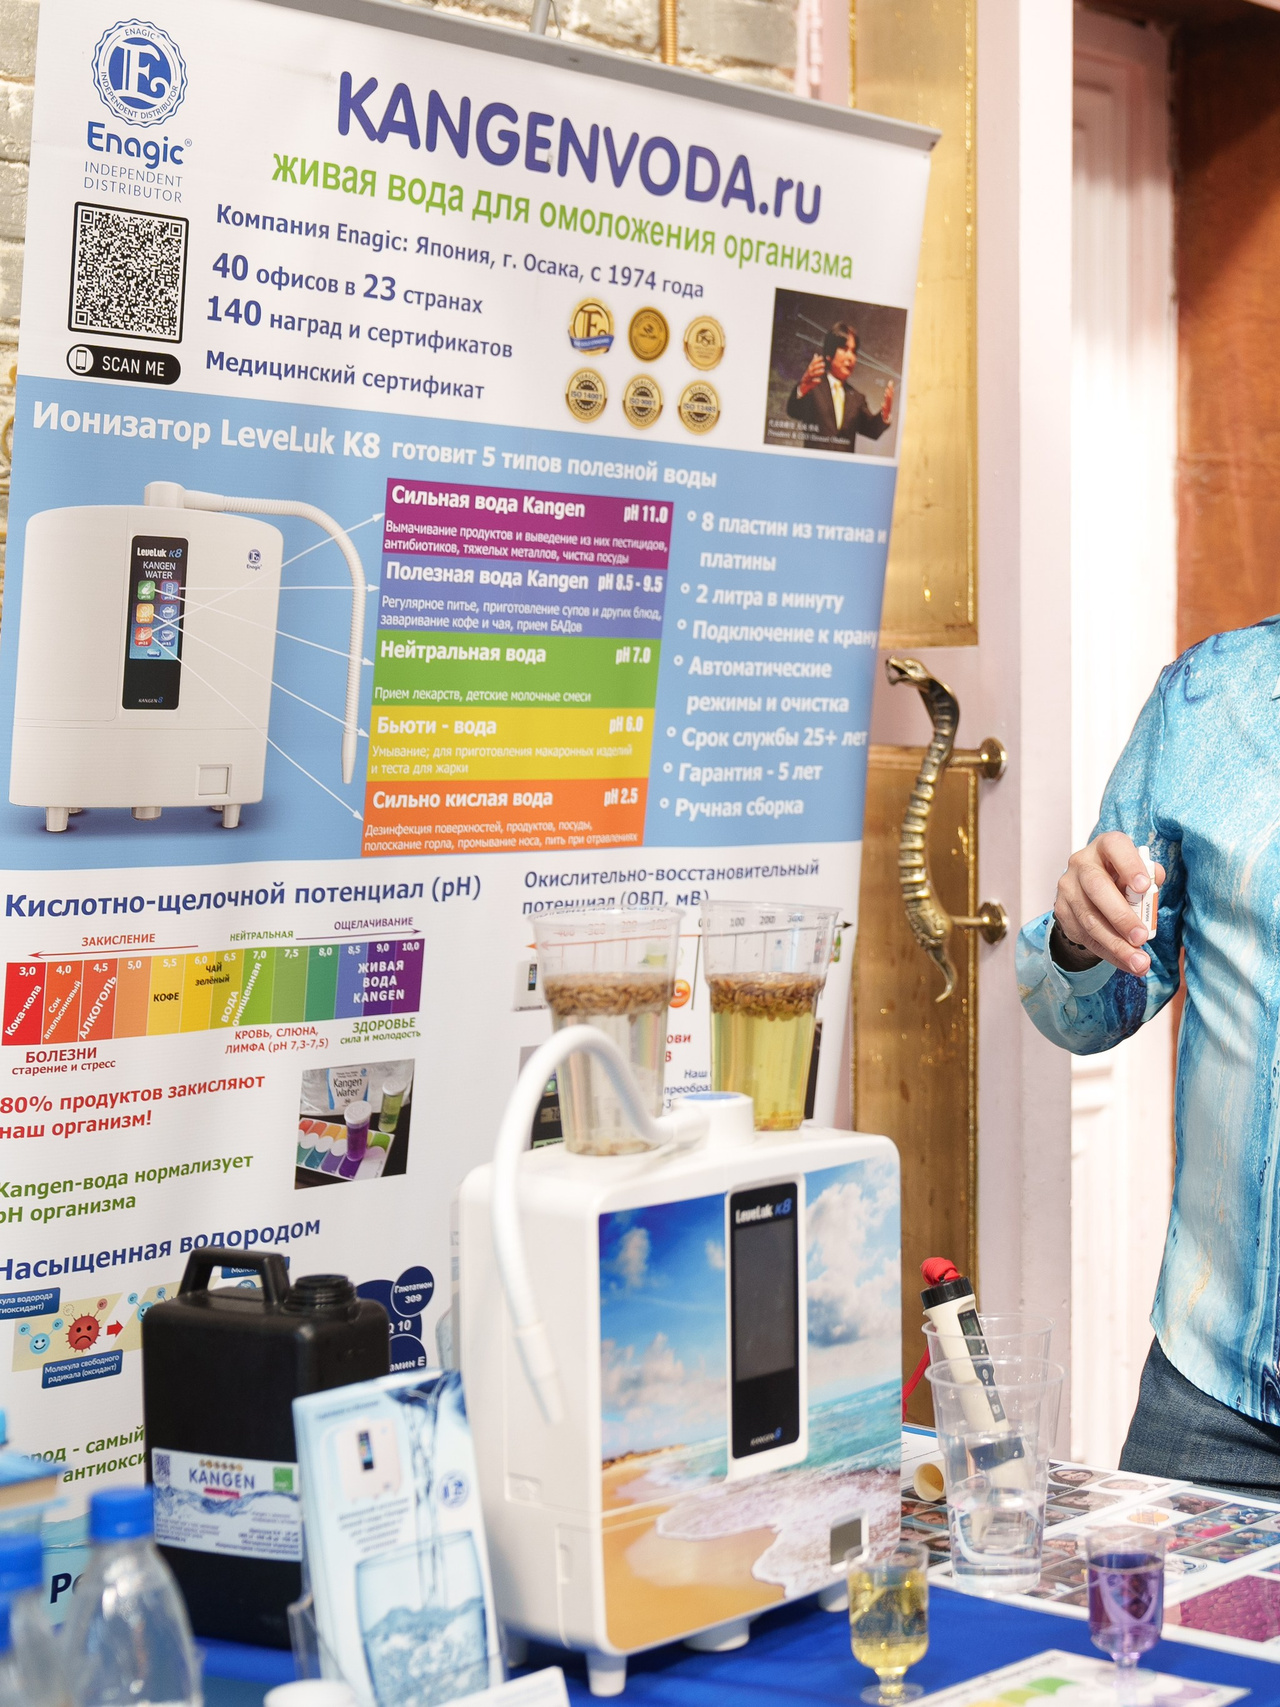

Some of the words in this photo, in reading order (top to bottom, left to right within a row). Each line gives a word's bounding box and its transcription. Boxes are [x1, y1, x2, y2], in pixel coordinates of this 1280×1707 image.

[101, 71, 138, 118] INDEPENDENT
[140, 85, 179, 119] DISTRIBUTOR
[338, 71, 821, 224] KANGENVODA.ru
[85, 161, 183, 188] INDEPENDENT
[84, 177, 182, 203] DISTRIBUTOR
[272, 153, 376, 197] живая
[388, 174, 464, 216] вода
[472, 190, 530, 224] для
[540, 202, 716, 255] омоложения
[724, 233, 853, 280] организма
[217, 204, 330, 240] Компания
[337, 222, 408, 254] Enagic:
[416, 236, 496, 269] Япония,
[524, 253, 584, 284] Осака,
[609, 265, 656, 290] 1974
[663, 277, 704, 299] года
[212, 252, 249, 281] 40
[256, 265, 339, 296] офисов
[363, 273, 396, 301] 23
[402, 286, 483, 315] странах
[207, 295, 262, 327] 140
[269, 309, 342, 340] наград
[367, 325, 513, 360] сертификатов
[102, 355, 139, 374] SCAN
[145, 359, 165, 376] ME
[206, 350, 355, 387] Медицинский
[362, 370, 485, 400] сертификат
[33, 401, 211, 449] Ионизатор
[221, 419, 334, 455] LeveLuk
[343, 431, 381, 458] K8
[392, 443, 476, 466] готовит
[502, 451, 561, 473] типов
[567, 462, 657, 482] полезной
[664, 467, 717, 489] воды
[392, 485, 470, 508] Сильная
[475, 496, 517, 514] вода
[523, 496, 585, 520] Kangen
[643, 505, 668, 523] 11.0
[386, 520, 457, 538] Вымачивание
[460, 527, 512, 543] продуктов
[525, 533, 578, 545] выведение
[719, 517, 787, 537] пластин
[816, 525, 874, 543] титана
[385, 538, 459, 557] антибиотиков,
[143, 561, 176, 571] KANGEN
[700, 553, 776, 571] платины
[145, 571, 172, 579] WATER
[386, 562, 474, 584] Полезная
[480, 568, 522, 588] вода
[527, 570, 588, 592] Kangen
[382, 596, 444, 612] Регулярное
[483, 602, 560, 617] приготовление
[712, 588, 764, 609] литра
[782, 593, 844, 613] минуту
[381, 615, 449, 628] заваривание
[452, 616, 479, 630] кофе
[692, 620, 814, 643] Подключение
[381, 640, 500, 661] Нейтральная
[506, 647, 546, 664] вода
[688, 656, 832, 678] Автоматические
[375, 687, 409, 700] Прием
[413, 689, 463, 702] лекарств,
[466, 689, 507, 702] детские
[511, 691, 560, 702] молочные
[686, 696, 761, 715] режимы
[781, 696, 849, 713] очистка
[377, 716, 436, 734] Бьюти
[454, 718, 496, 735] вода
[682, 727, 729, 750] Срок
[732, 728, 798, 750] службы
[802, 727, 837, 746] 25+
[456, 747, 532, 759] приготовления
[679, 762, 762, 785] Гарантия
[792, 764, 822, 780] лет
[373, 791, 440, 809] Сильно
[446, 792, 507, 807] кислая
[513, 791, 553, 807] вода
[675, 798, 741, 821] Ручная
[747, 796, 804, 818] сборка
[365, 824, 432, 837] Дезинфекция
[364, 839, 422, 851] полоскание
[524, 858, 820, 888] Окислительно-восстановительный
[5, 882, 285, 918] Кислотно-щелочной
[295, 881, 423, 904] потенциал
[432, 874, 481, 902] (pH)
[334, 917, 413, 931] ОЩЕЛАЧИВАНИЕ
[82, 933, 155, 947] ЗАКИСЛЕНИЕ
[230, 930, 294, 941] НЕЙТРАЛЬНАЯ
[253, 950, 267, 960] 7,0
[402, 941, 420, 952] 10,0
[19, 966, 36, 976] 3,0
[56, 965, 72, 975] 4,0
[94, 962, 109, 973] 4,5
[358, 960, 404, 973] ЖИВАЯ
[363, 975, 397, 988] ВОДА
[48, 997, 62, 1013] Сок
[153, 992, 179, 1002] КОФЕ
[232, 962, 262, 1027] очищенная
[353, 989, 404, 1004] KANGEN
[4, 984, 42, 1036] Кока-кола
[79, 975, 117, 1040] АЛКОГОЛЬ
[352, 1017, 416, 1034] ЗДОРОВЬЕ
[25, 1047, 97, 1063] БОЛЕЗНИ
[225, 1041, 266, 1054] ЛИМФА
[12, 1063, 67, 1076] старение
[81, 1060, 116, 1070] стресс
[0, 1095, 52, 1114] 80%
[59, 1085, 163, 1110] продуктов
[168, 1075, 265, 1099] закисляют
[0, 1121, 45, 1139] наш
[51, 1110, 152, 1138] организм!
[135, 1153, 253, 1183] нормализует
[30, 1194, 136, 1224] организма
[0, 1240, 171, 1281] Насыщенная
[180, 1219, 320, 1249] водородом
[19, 1293, 53, 1303] водорода
[45, 1362, 80, 1374] Молекула
[81, 1353, 119, 1368] свободного
[48, 1372, 81, 1384] радикала
[82, 1364, 117, 1378] (оксидант)
[85, 1425, 144, 1453] самый
[63, 1452, 147, 1483] антиокси
[189, 1468, 255, 1489] KANGEN
